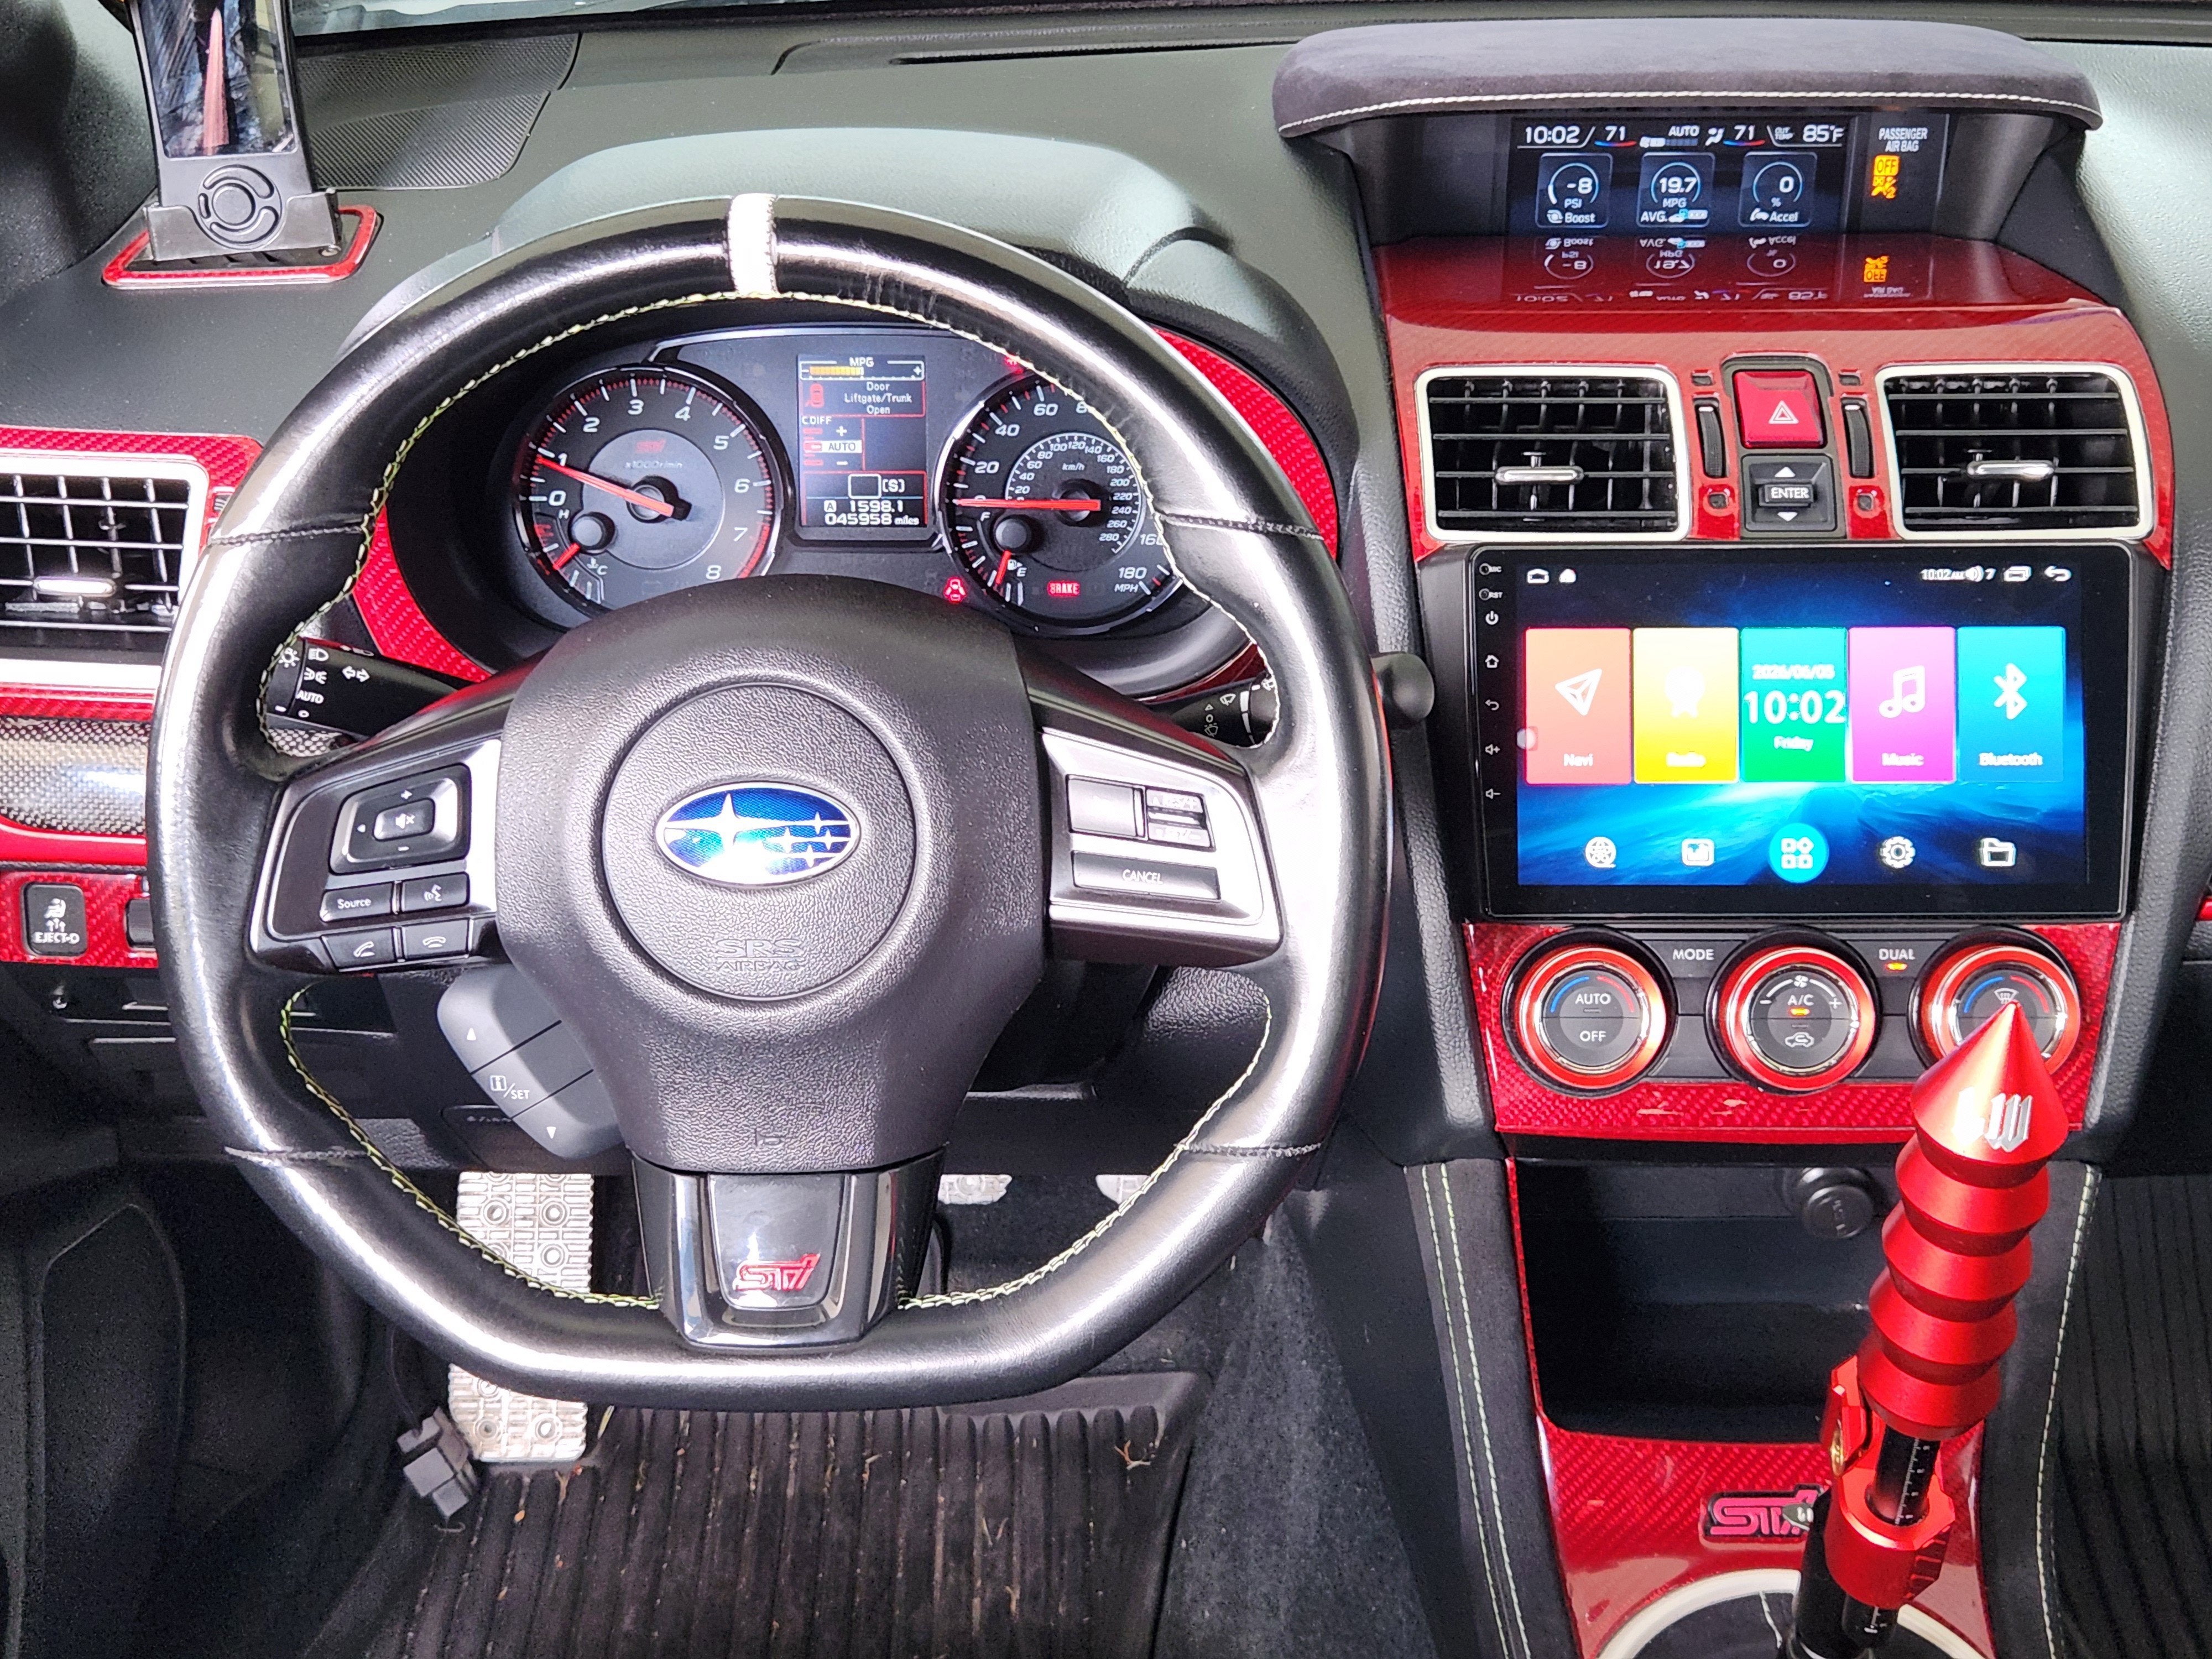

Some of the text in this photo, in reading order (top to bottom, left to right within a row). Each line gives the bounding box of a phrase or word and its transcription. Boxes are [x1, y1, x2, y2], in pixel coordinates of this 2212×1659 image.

[1525, 126, 1580, 144] 10:02
[1605, 126, 1626, 141] 71
[1668, 125, 1700, 137] AUTO
[1734, 125, 1756, 140] 71
[1803, 124, 1845, 143] 85°F
[1879, 127, 1928, 140] PASSENGER
[1885, 140, 1919, 152] AIR BAG
[1876, 159, 1897, 174] OFF
[1567, 177, 1593, 194] -8
[1659, 176, 1697, 194] 19.7
[1779, 176, 1794, 193] 0
[1564, 199, 1583, 208] PSI
[1662, 198, 1687, 208] MPG
[1564, 212, 1595, 223] Boost
[1640, 211, 1667, 222] AVG.
[1769, 211, 1798, 222] Accel
[849, 357, 874, 367] MPG
[866, 382, 890, 391] Door
[844, 393, 913, 404] Liftgate/Trunk
[628, 399, 644, 415] 3
[866, 405, 891, 415] Open
[1034, 403, 1058, 416] 60
[675, 406, 691, 421] 4
[583, 417, 600, 432] 2
[995, 424, 1020, 436] 40
[713, 435, 729, 450] 5
[828, 442, 857, 451] AUTO
[1050, 443, 1068, 451] 100
[1068, 441, 1087, 450] 120
[1037, 451, 1053, 460] 80
[1084, 446, 1103, 454] 140
[558, 452, 567, 467] 1
[1097, 454, 1115, 463] 160
[974, 461, 1000, 474] 20
[1027, 461, 1043, 469] 60
[1062, 462, 1086, 471] km/h
[1107, 465, 1125, 474] 180
[1019, 472, 1035, 481] 40
[1110, 478, 1130, 487] 200
[734, 478, 750, 493] 6
[1014, 486, 1031, 494] 20
[548, 490, 567, 506] 0
[1113, 492, 1133, 500] 220
[1770, 487, 1809, 499] ENTER
[849, 500, 903, 512] 1598.1
[559, 509, 570, 519] H
[825, 513, 920, 525] 045958 miles
[980, 512, 991, 521] F
[1107, 520, 1128, 528] 260
[734, 526, 748, 541] 7
[1099, 533, 1119, 541] 280
[597, 565, 608, 575] C
[706, 565, 722, 580] 8
[1017, 567, 1027, 577] E
[1118, 567, 1147, 579] 180
[1984, 568, 1997, 581] 7
[1049, 582, 1080, 596] BRAKE
[1114, 583, 1139, 593] MPH
[296, 689, 325, 704] AUTO
[1743, 689, 1847, 724] 10:02
[1773, 735, 1814, 752] Friday
[1563, 753, 1594, 767] Navi
[1881, 752, 1924, 766] Music
[1979, 752, 2043, 766] Bluetooth
[1121, 869, 1164, 885] CANCEL
[337, 897, 372, 909] Source
[717, 939, 802, 958] SRS
[1672, 948, 1715, 961] MODE
[1879, 948, 1916, 961] DUAL
[1575, 993, 1611, 1005] AUTO
[1787, 994, 1814, 1005] A/C
[1579, 1030, 1606, 1042] OFF
